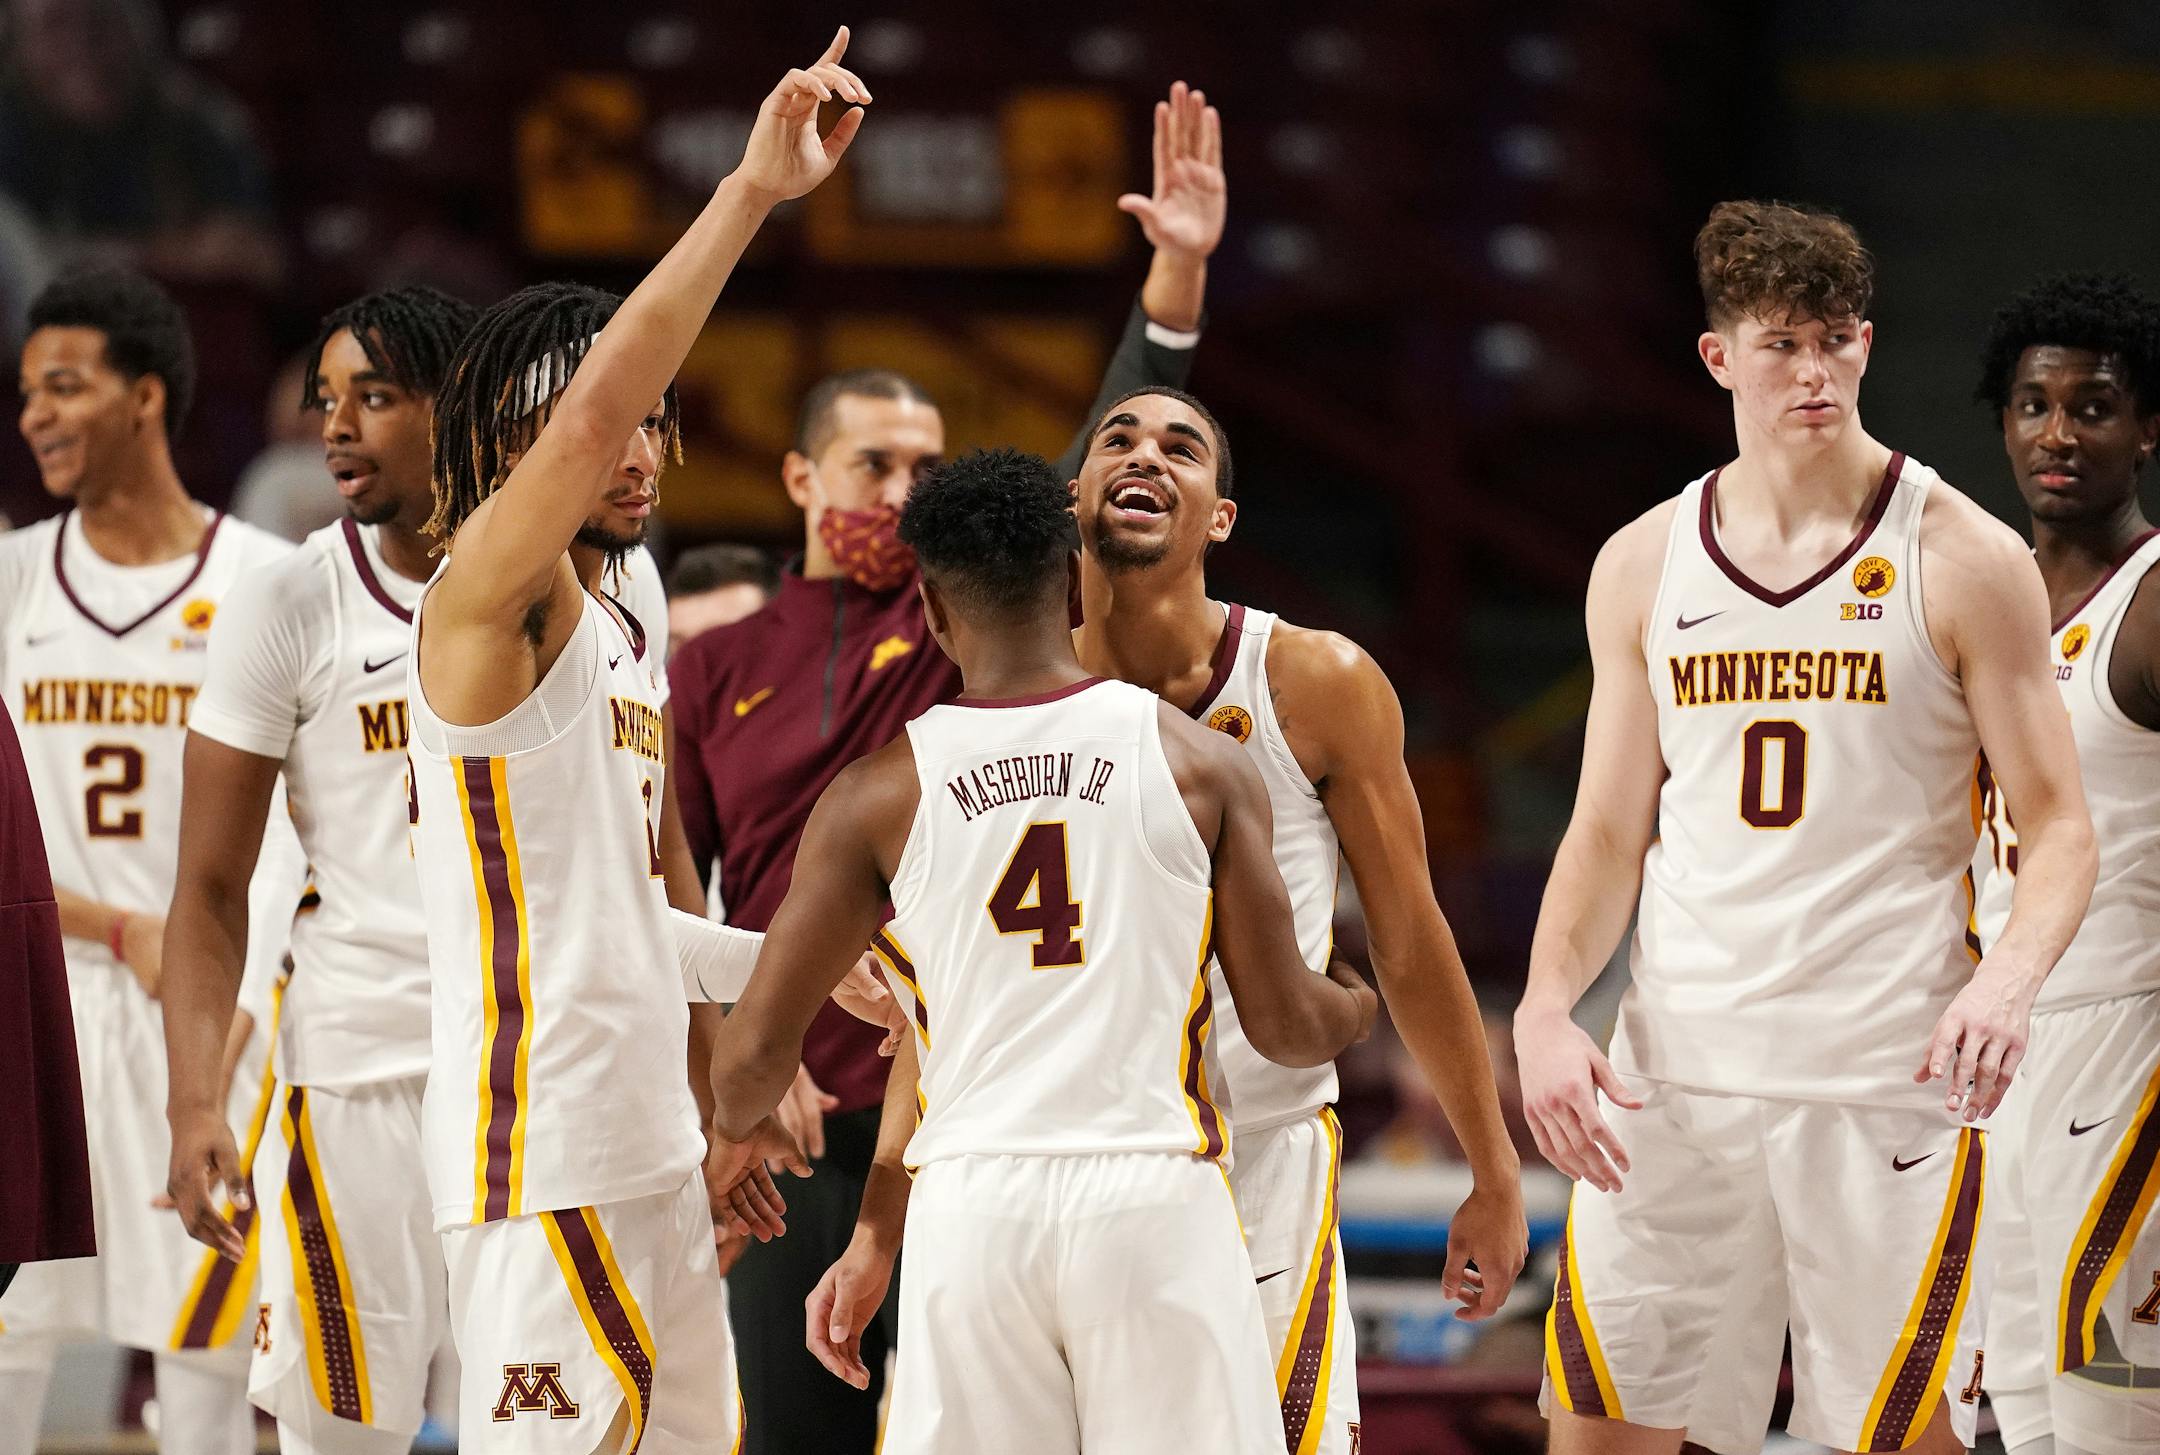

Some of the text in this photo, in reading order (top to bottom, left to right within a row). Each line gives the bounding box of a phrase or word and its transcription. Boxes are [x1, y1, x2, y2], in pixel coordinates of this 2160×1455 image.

[22, 678, 201, 729] MINNESOT
[1669, 649, 1888, 708] MINNESOTA
[1214, 708, 1247, 720] LOVE US
[84, 743, 144, 840] 2
[947, 752, 1114, 822] MASHBURN JR.
[1738, 718, 1809, 830] 0
[986, 820, 1086, 970] 4
[491, 1362, 580, 1422] M
